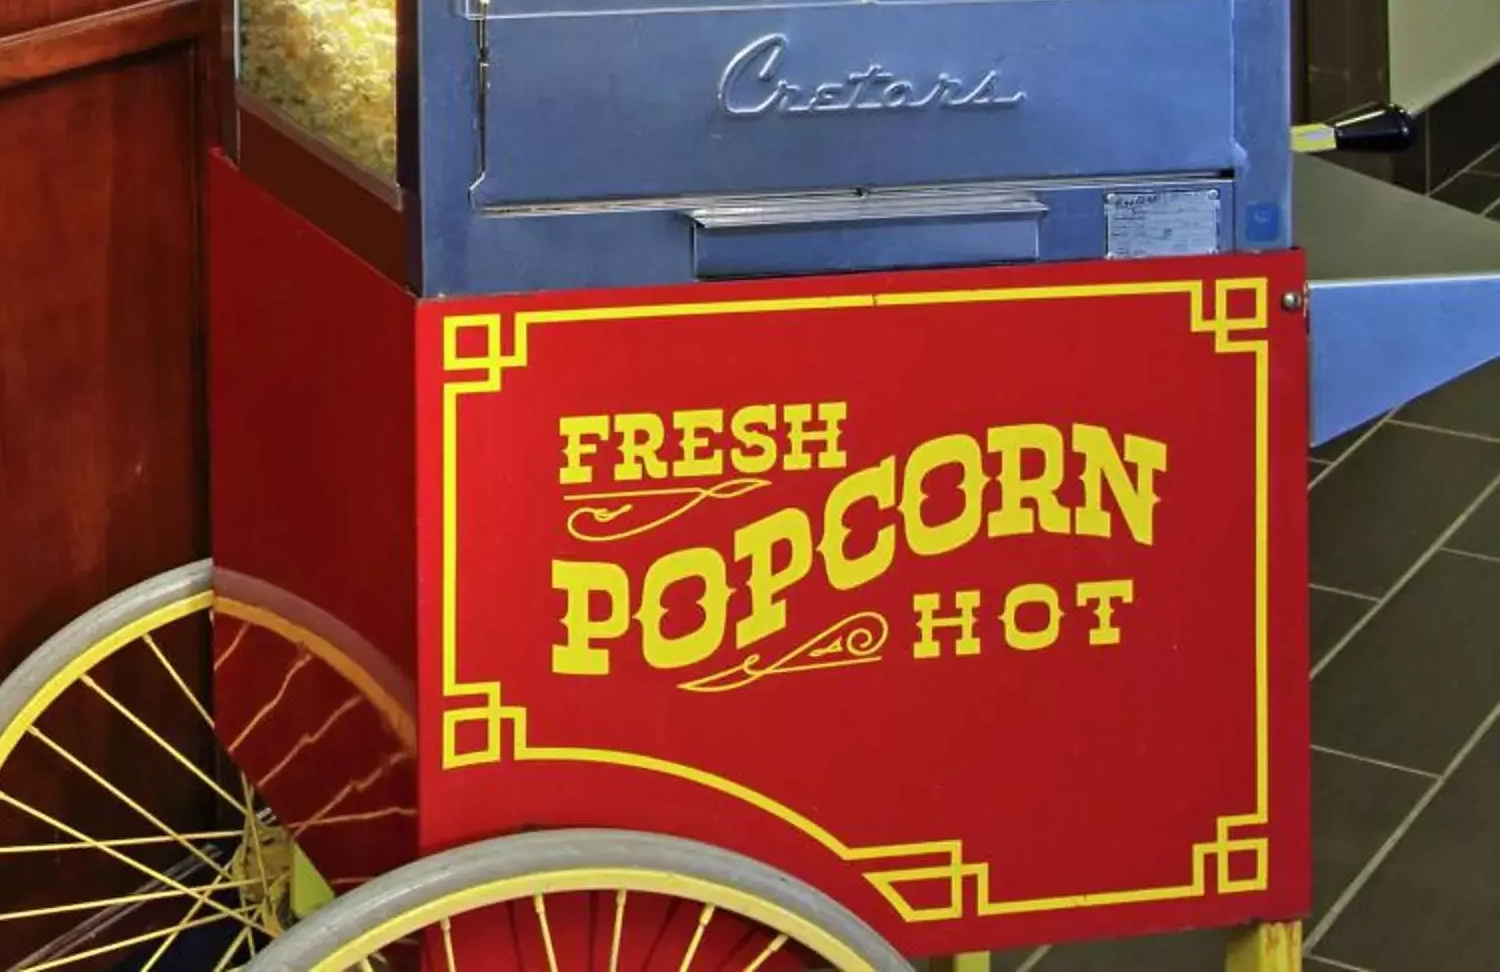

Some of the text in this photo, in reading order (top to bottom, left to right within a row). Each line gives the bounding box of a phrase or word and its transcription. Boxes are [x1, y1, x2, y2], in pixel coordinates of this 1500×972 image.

[718, 32, 1028, 115] Cretors
[559, 401, 848, 485] FRESH
[551, 422, 1168, 675] POPCORN
[913, 579, 1134, 659] HOT
